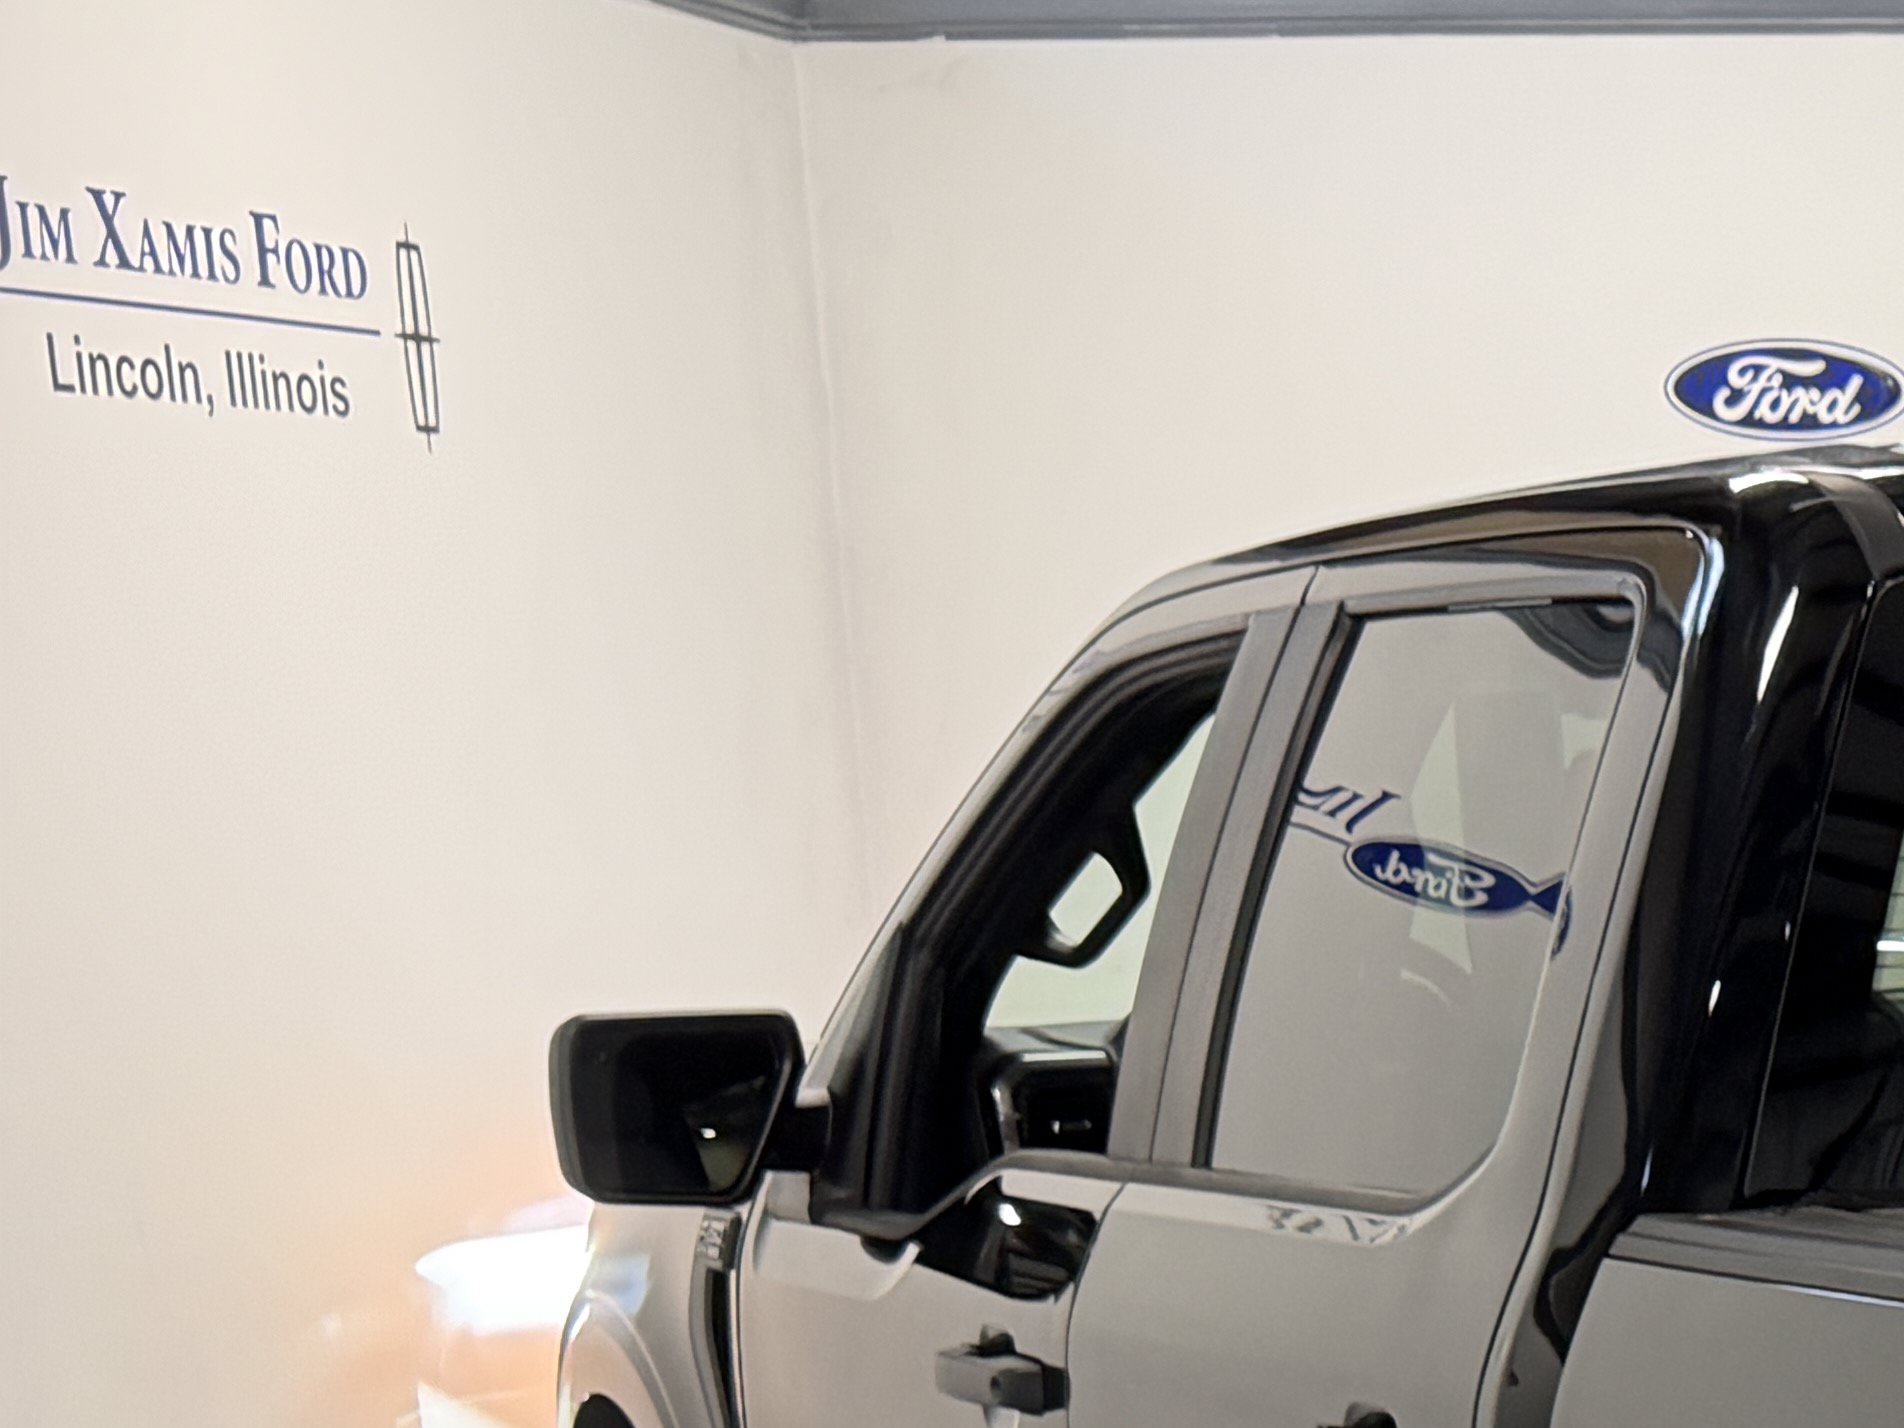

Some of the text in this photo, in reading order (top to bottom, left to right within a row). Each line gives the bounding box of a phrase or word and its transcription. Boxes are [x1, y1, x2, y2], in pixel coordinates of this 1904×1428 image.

[46, 332, 350, 418] Lincoln, Illinois
[1712, 355, 1864, 424] Ford
